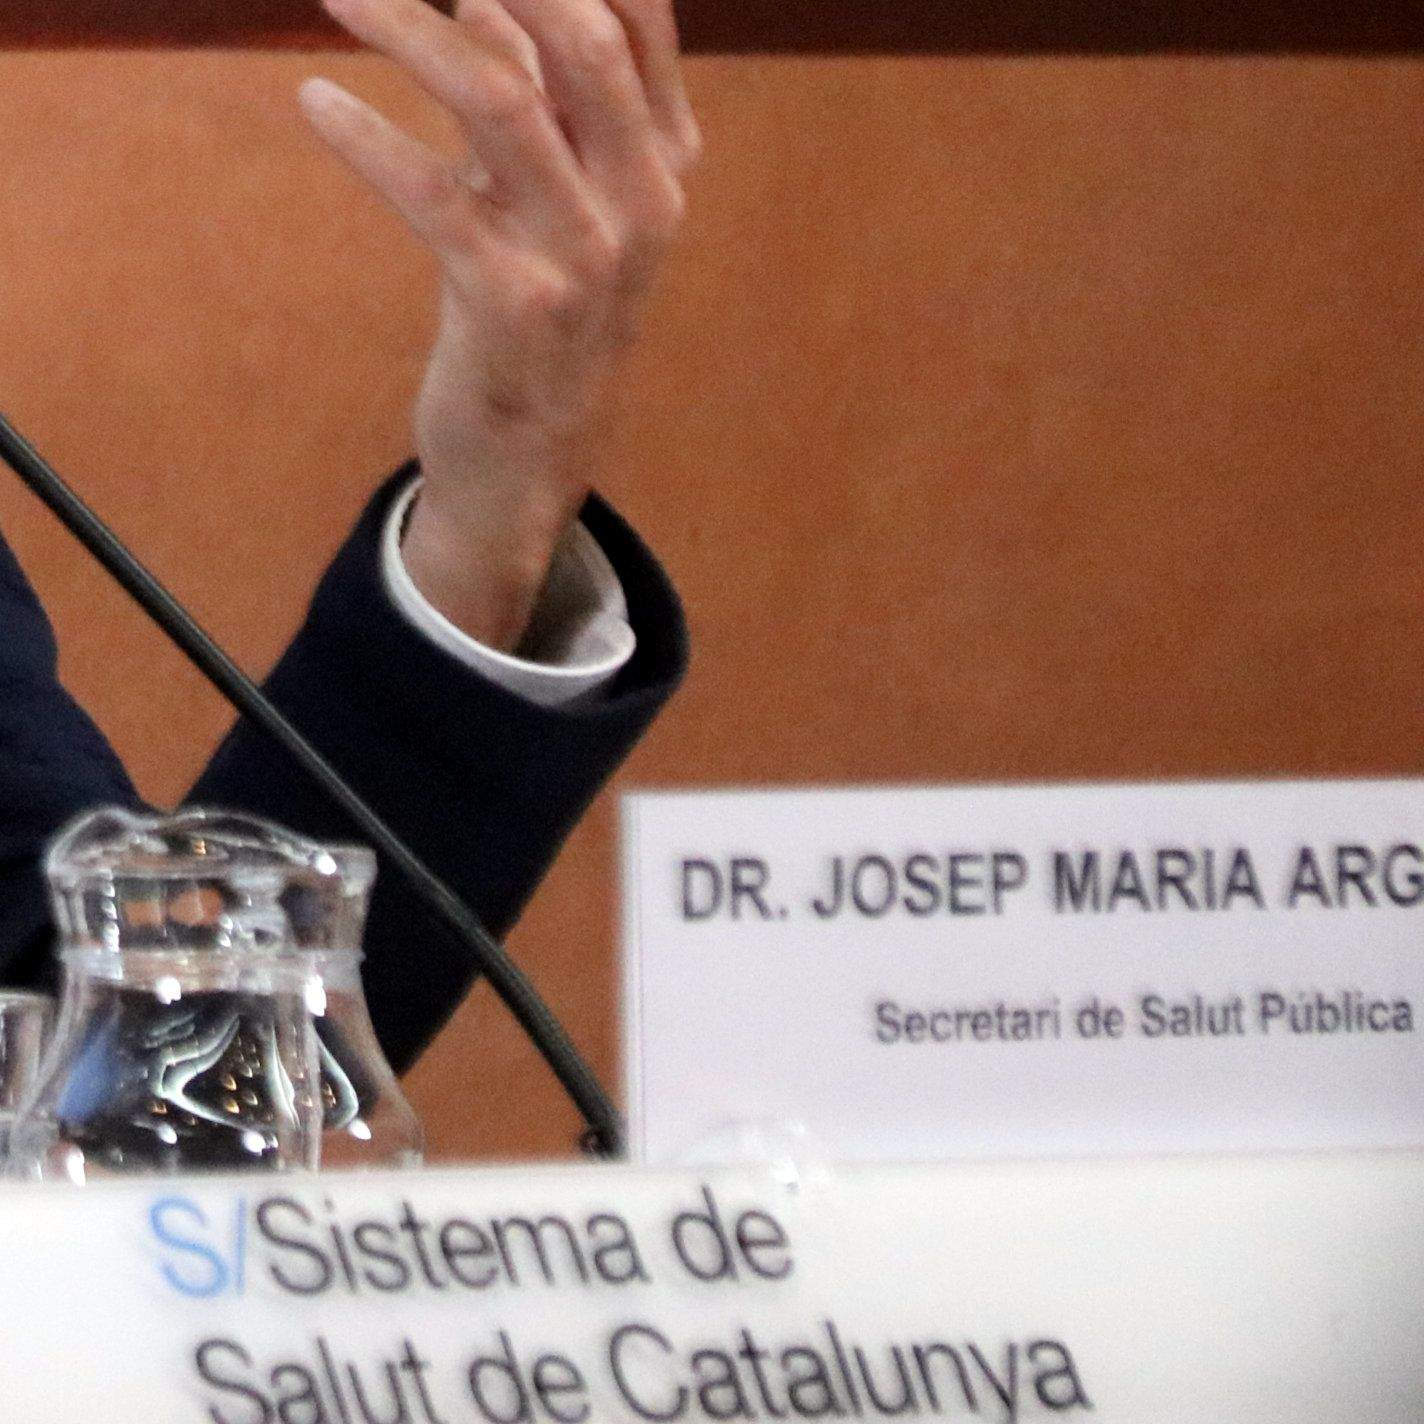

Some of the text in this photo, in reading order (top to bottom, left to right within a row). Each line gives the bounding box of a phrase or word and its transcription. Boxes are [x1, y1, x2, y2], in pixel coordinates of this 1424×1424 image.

[678, 842, 1424, 922] DR. JOSEP MARIA ARG
[874, 989, 1416, 1044] Secretari de Salut Pública
[670, 1183, 795, 1282] de
[194, 1318, 1096, 1424] Salut de Catalunya
